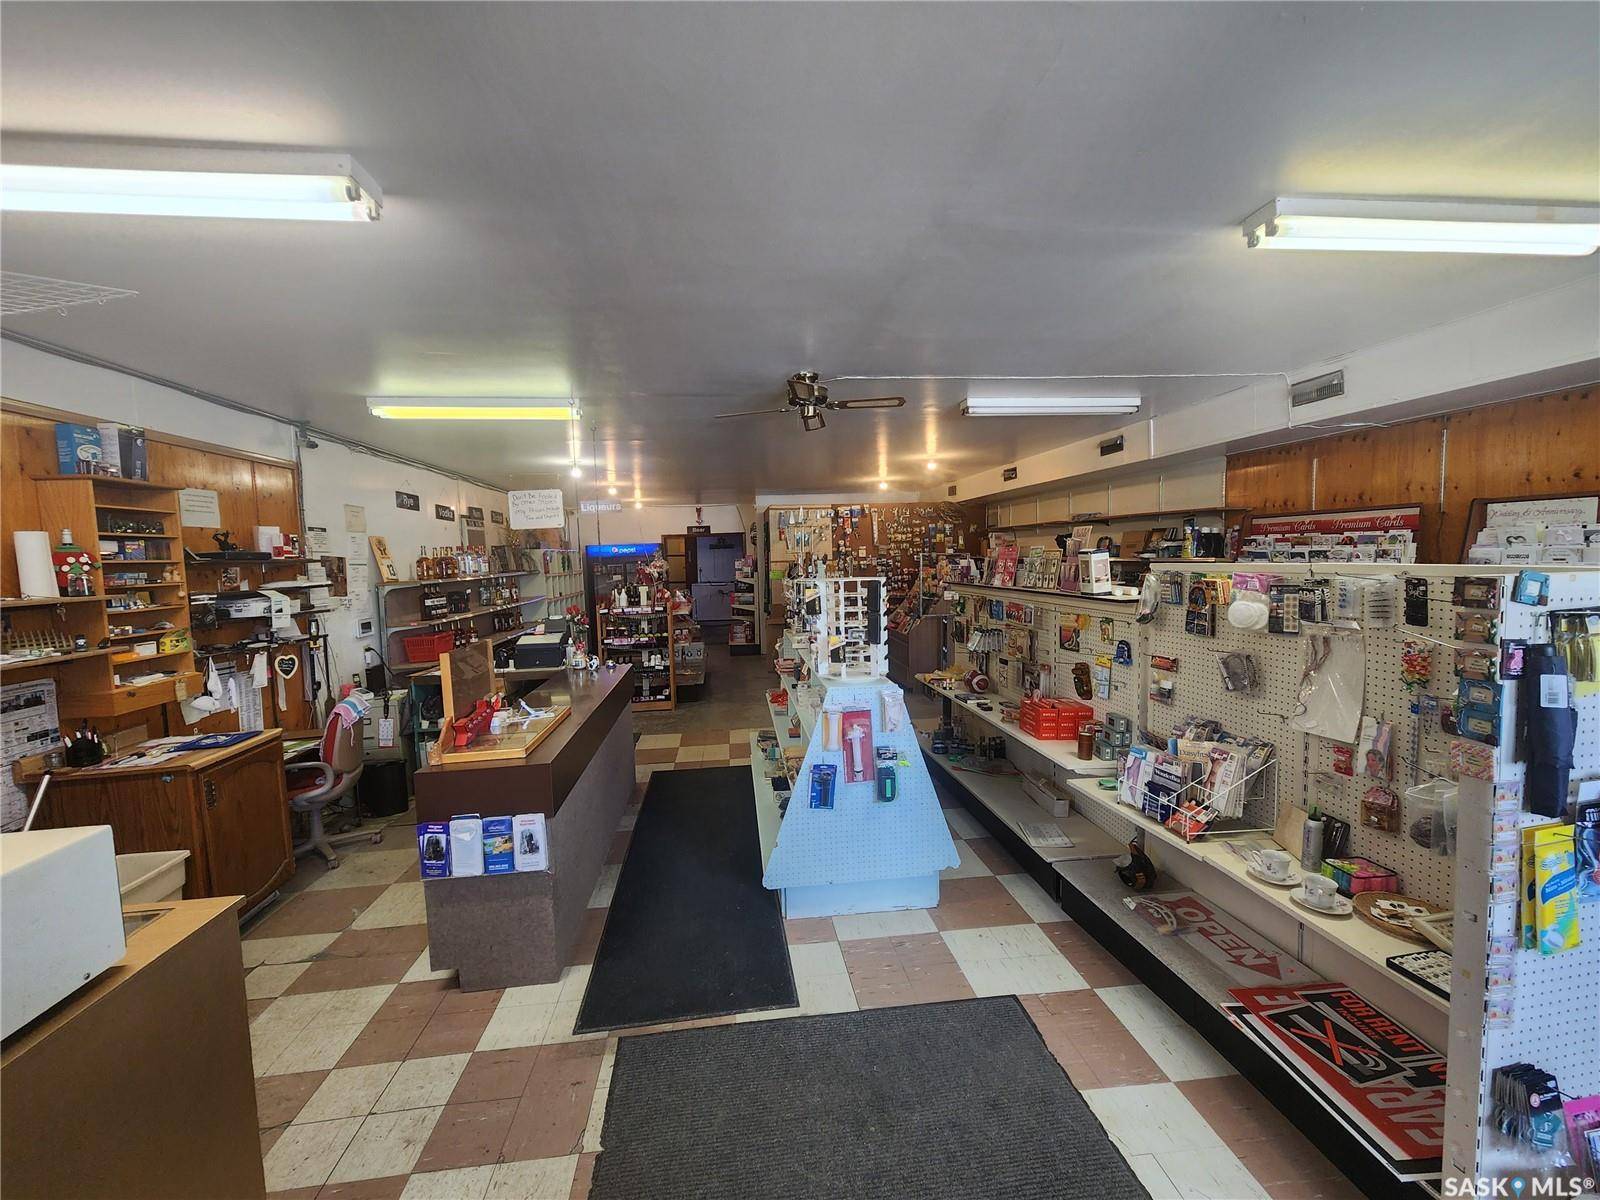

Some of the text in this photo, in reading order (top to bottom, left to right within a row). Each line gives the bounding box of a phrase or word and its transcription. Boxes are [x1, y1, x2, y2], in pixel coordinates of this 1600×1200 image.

[403, 495, 414, 507] Rye
[439, 507, 453, 518] Vodka
[1260, 521, 1316, 532] Premium Cards
[1331, 515, 1404, 529] Premium Cards
[386, 564, 396, 577] 13
[1175, 907, 1279, 968] OPEN
[1330, 992, 1430, 1053] FOR RENT
